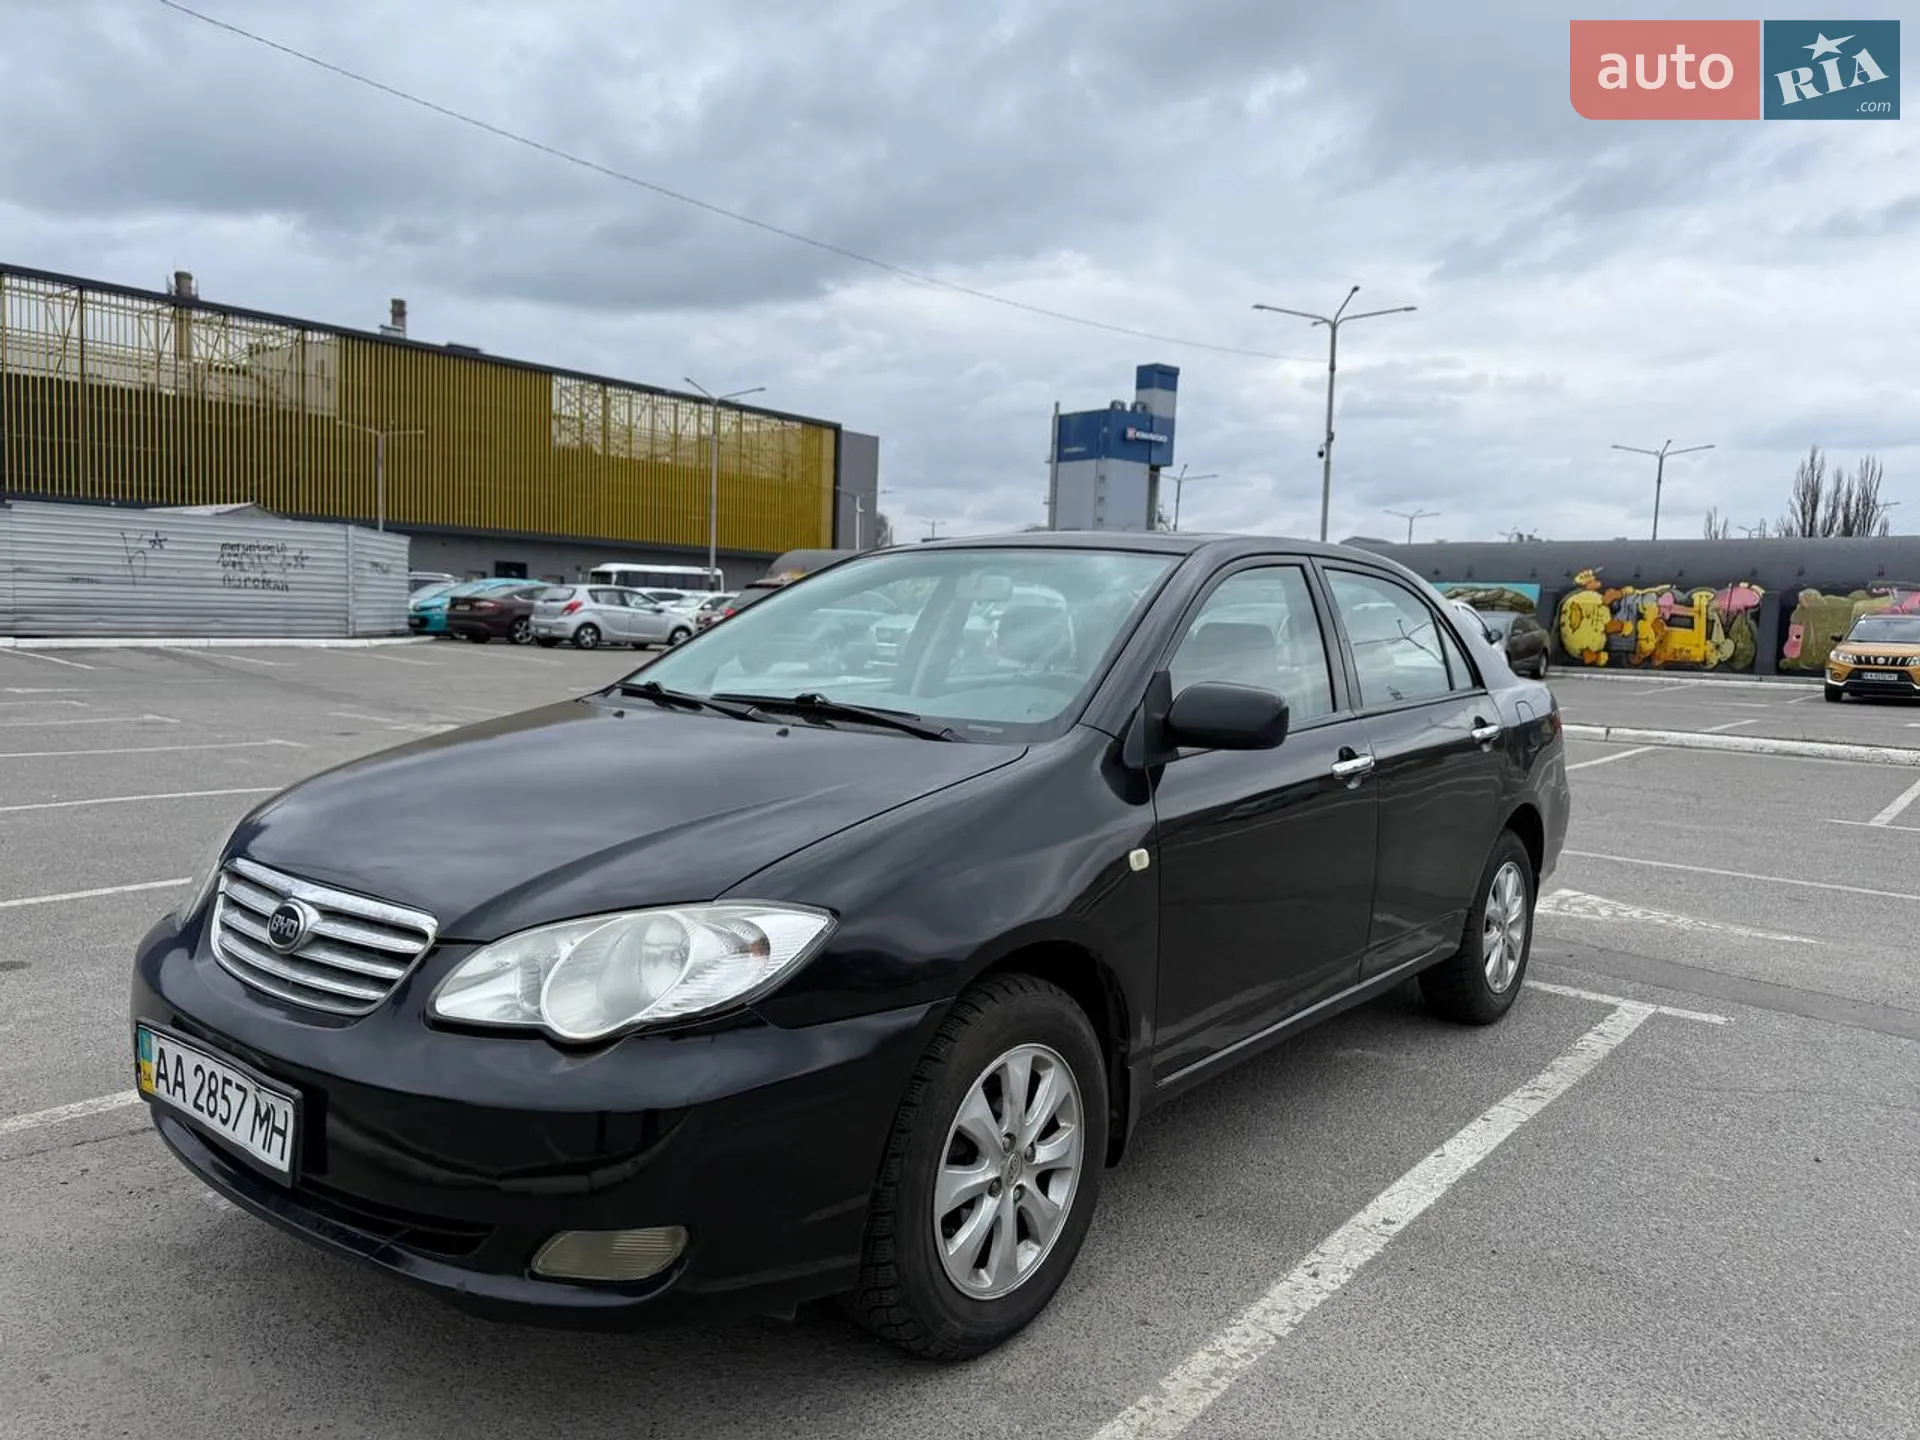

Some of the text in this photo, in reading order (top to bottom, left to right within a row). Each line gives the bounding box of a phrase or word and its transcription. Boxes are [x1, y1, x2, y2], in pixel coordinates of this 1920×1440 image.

[270, 913, 299, 939] BYD
[155, 1047, 289, 1162] AA 2857 MH
